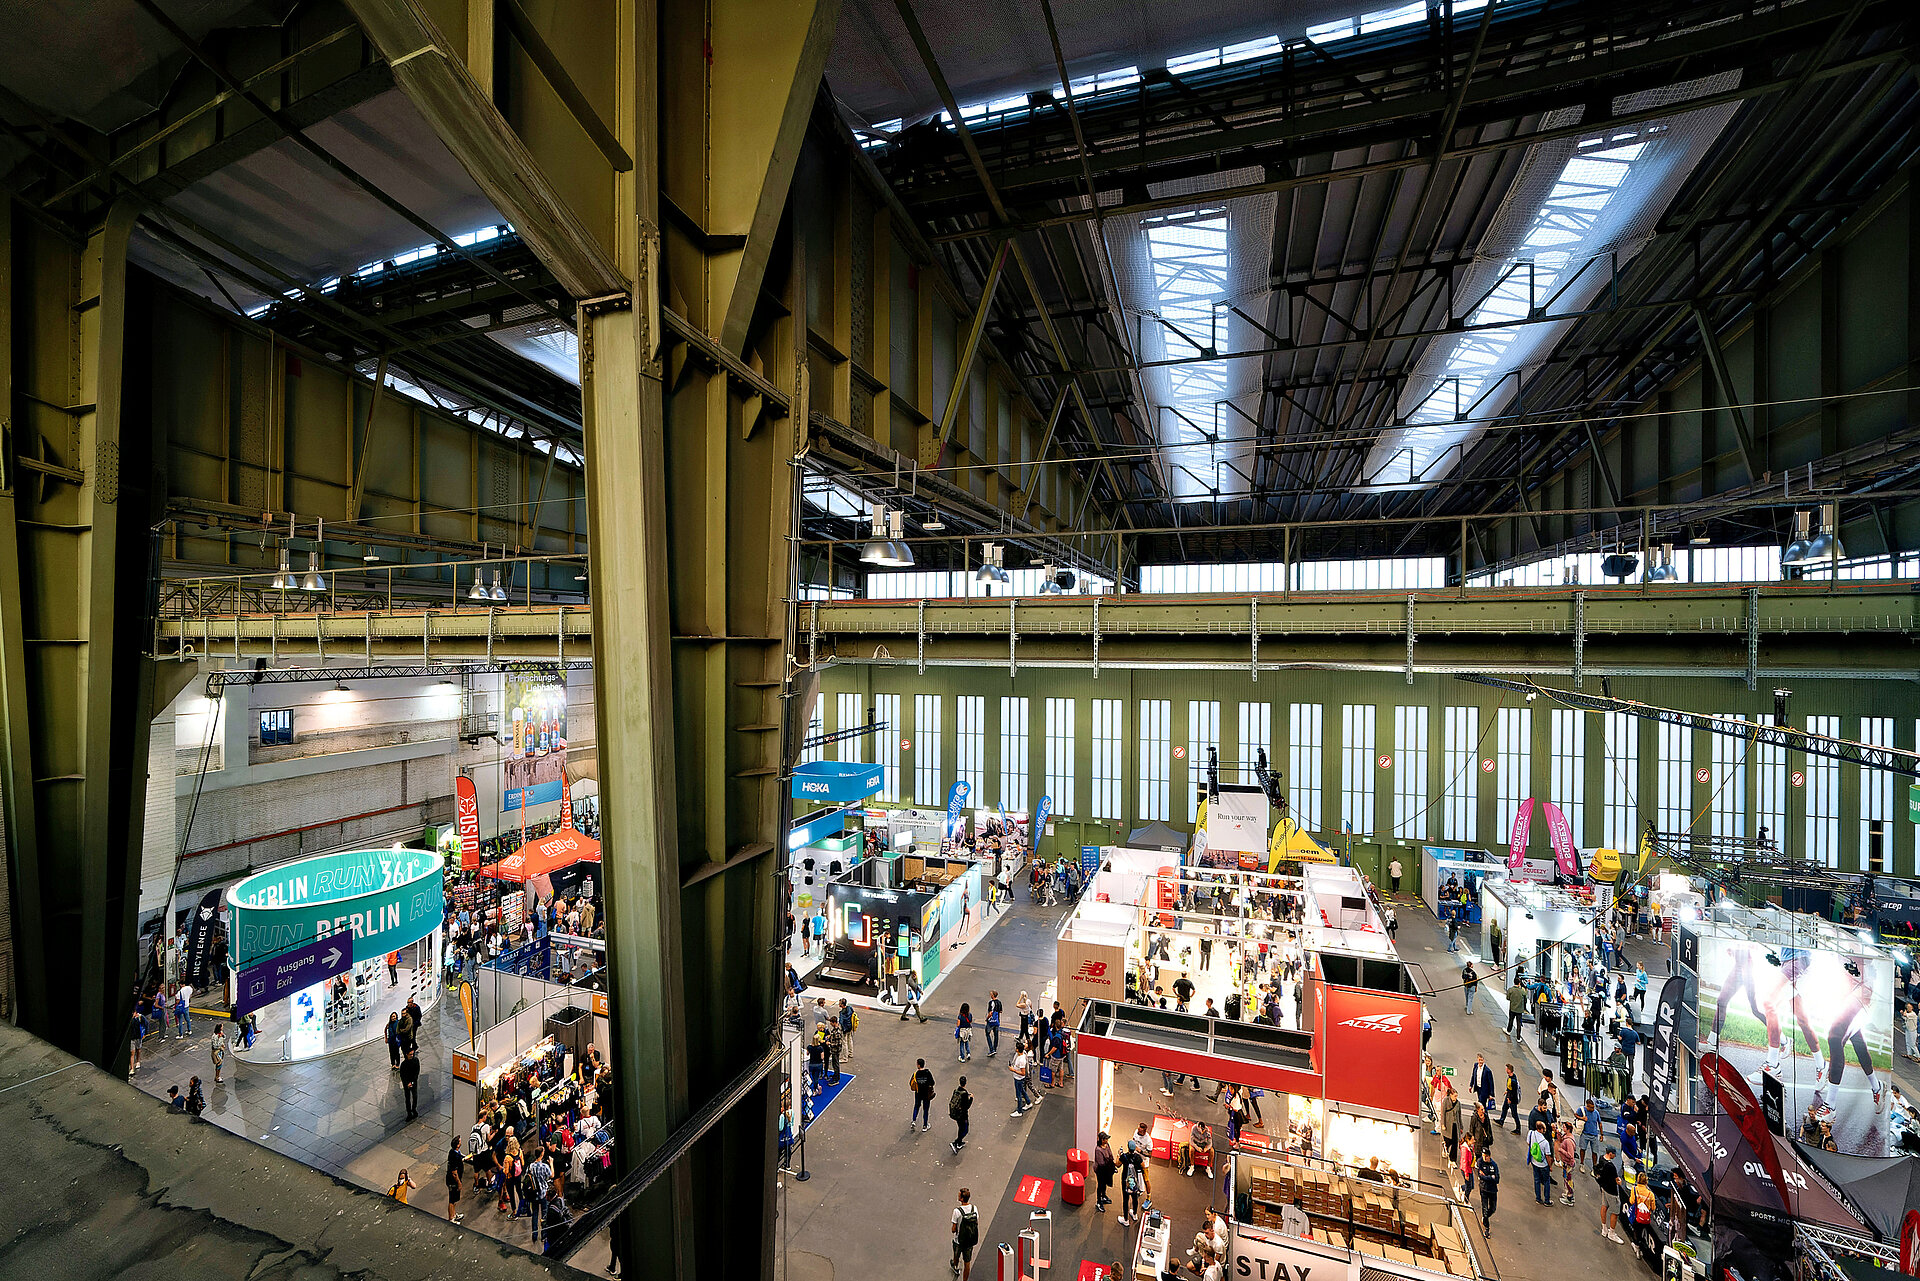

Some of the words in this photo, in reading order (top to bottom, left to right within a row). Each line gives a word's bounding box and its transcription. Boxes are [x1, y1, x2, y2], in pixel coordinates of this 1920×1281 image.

[508, 674, 559, 684] Erfrischungs-
[802, 781, 830, 793] HOKA
[866, 775, 880, 788] HOKA
[1231, 814, 1245, 822] your
[1246, 815, 1258, 823] way
[460, 815, 478, 851] OTSO
[1513, 814, 1524, 852] SQUEEZY
[540, 840, 565, 856] OTSO
[313, 865, 375, 895] RUN
[316, 902, 400, 942] BERLIN
[193, 925, 208, 976] INCYLENCE
[276, 954, 315, 976] Ausgang
[276, 975, 293, 990] Exit
[1085, 976, 1111, 985] balance
[1337, 1020, 1402, 1034] ALTRA
[1652, 1001, 1675, 1102] PILLAR
[1691, 1120, 1728, 1160] PILLAR
[1743, 1161, 1809, 1190] PILAR
[1750, 1211, 1776, 1222] SPORTS
[1236, 1255, 1312, 1281] STAY
